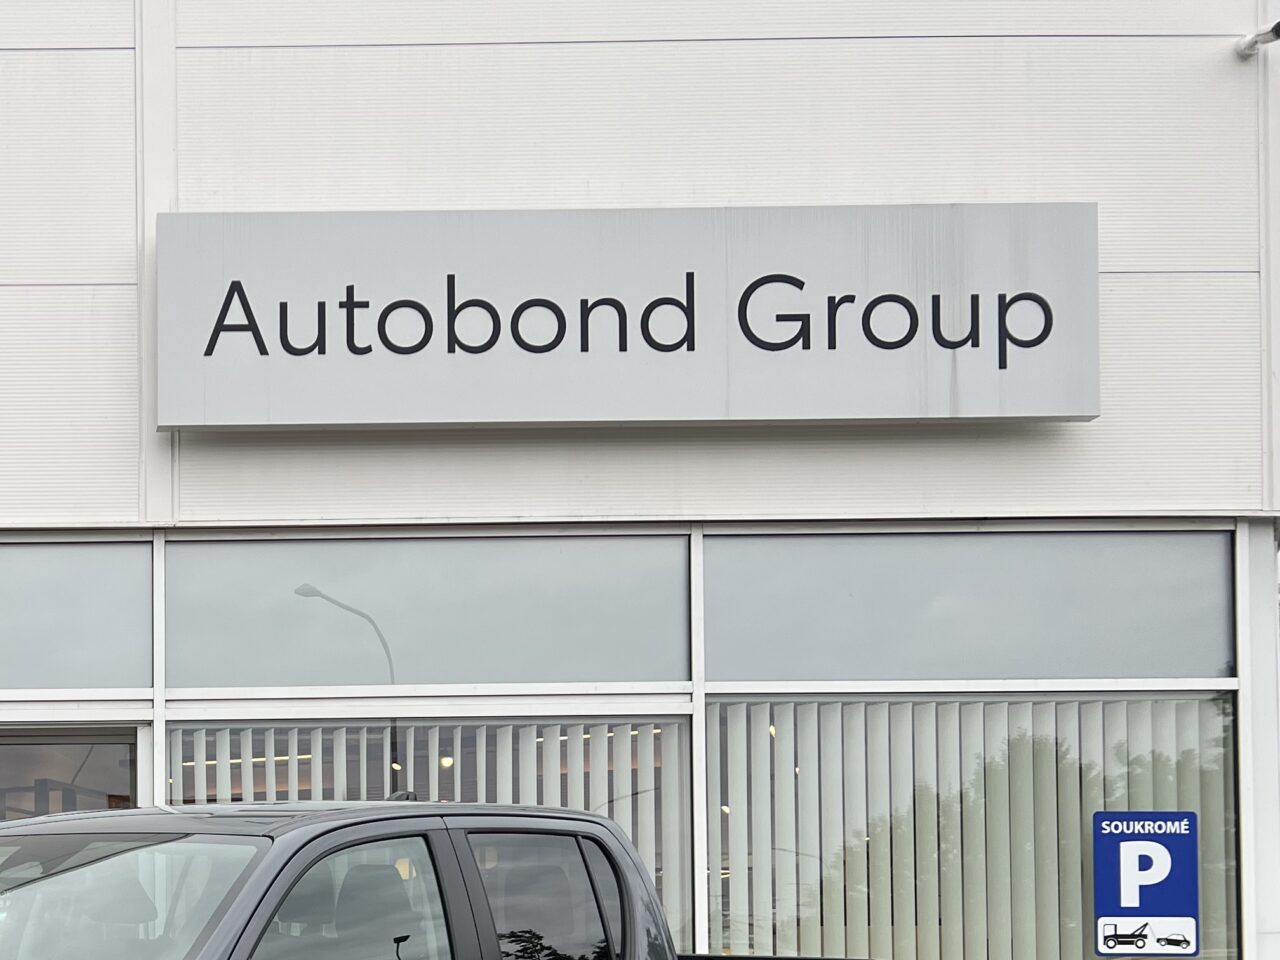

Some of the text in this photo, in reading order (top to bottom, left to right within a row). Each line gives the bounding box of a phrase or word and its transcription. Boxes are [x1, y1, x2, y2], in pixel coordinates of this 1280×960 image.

[203, 271, 1055, 370] Autobond Group
[1101, 818, 1190, 834] SOUKROMÉ
[1120, 840, 1172, 908] P
